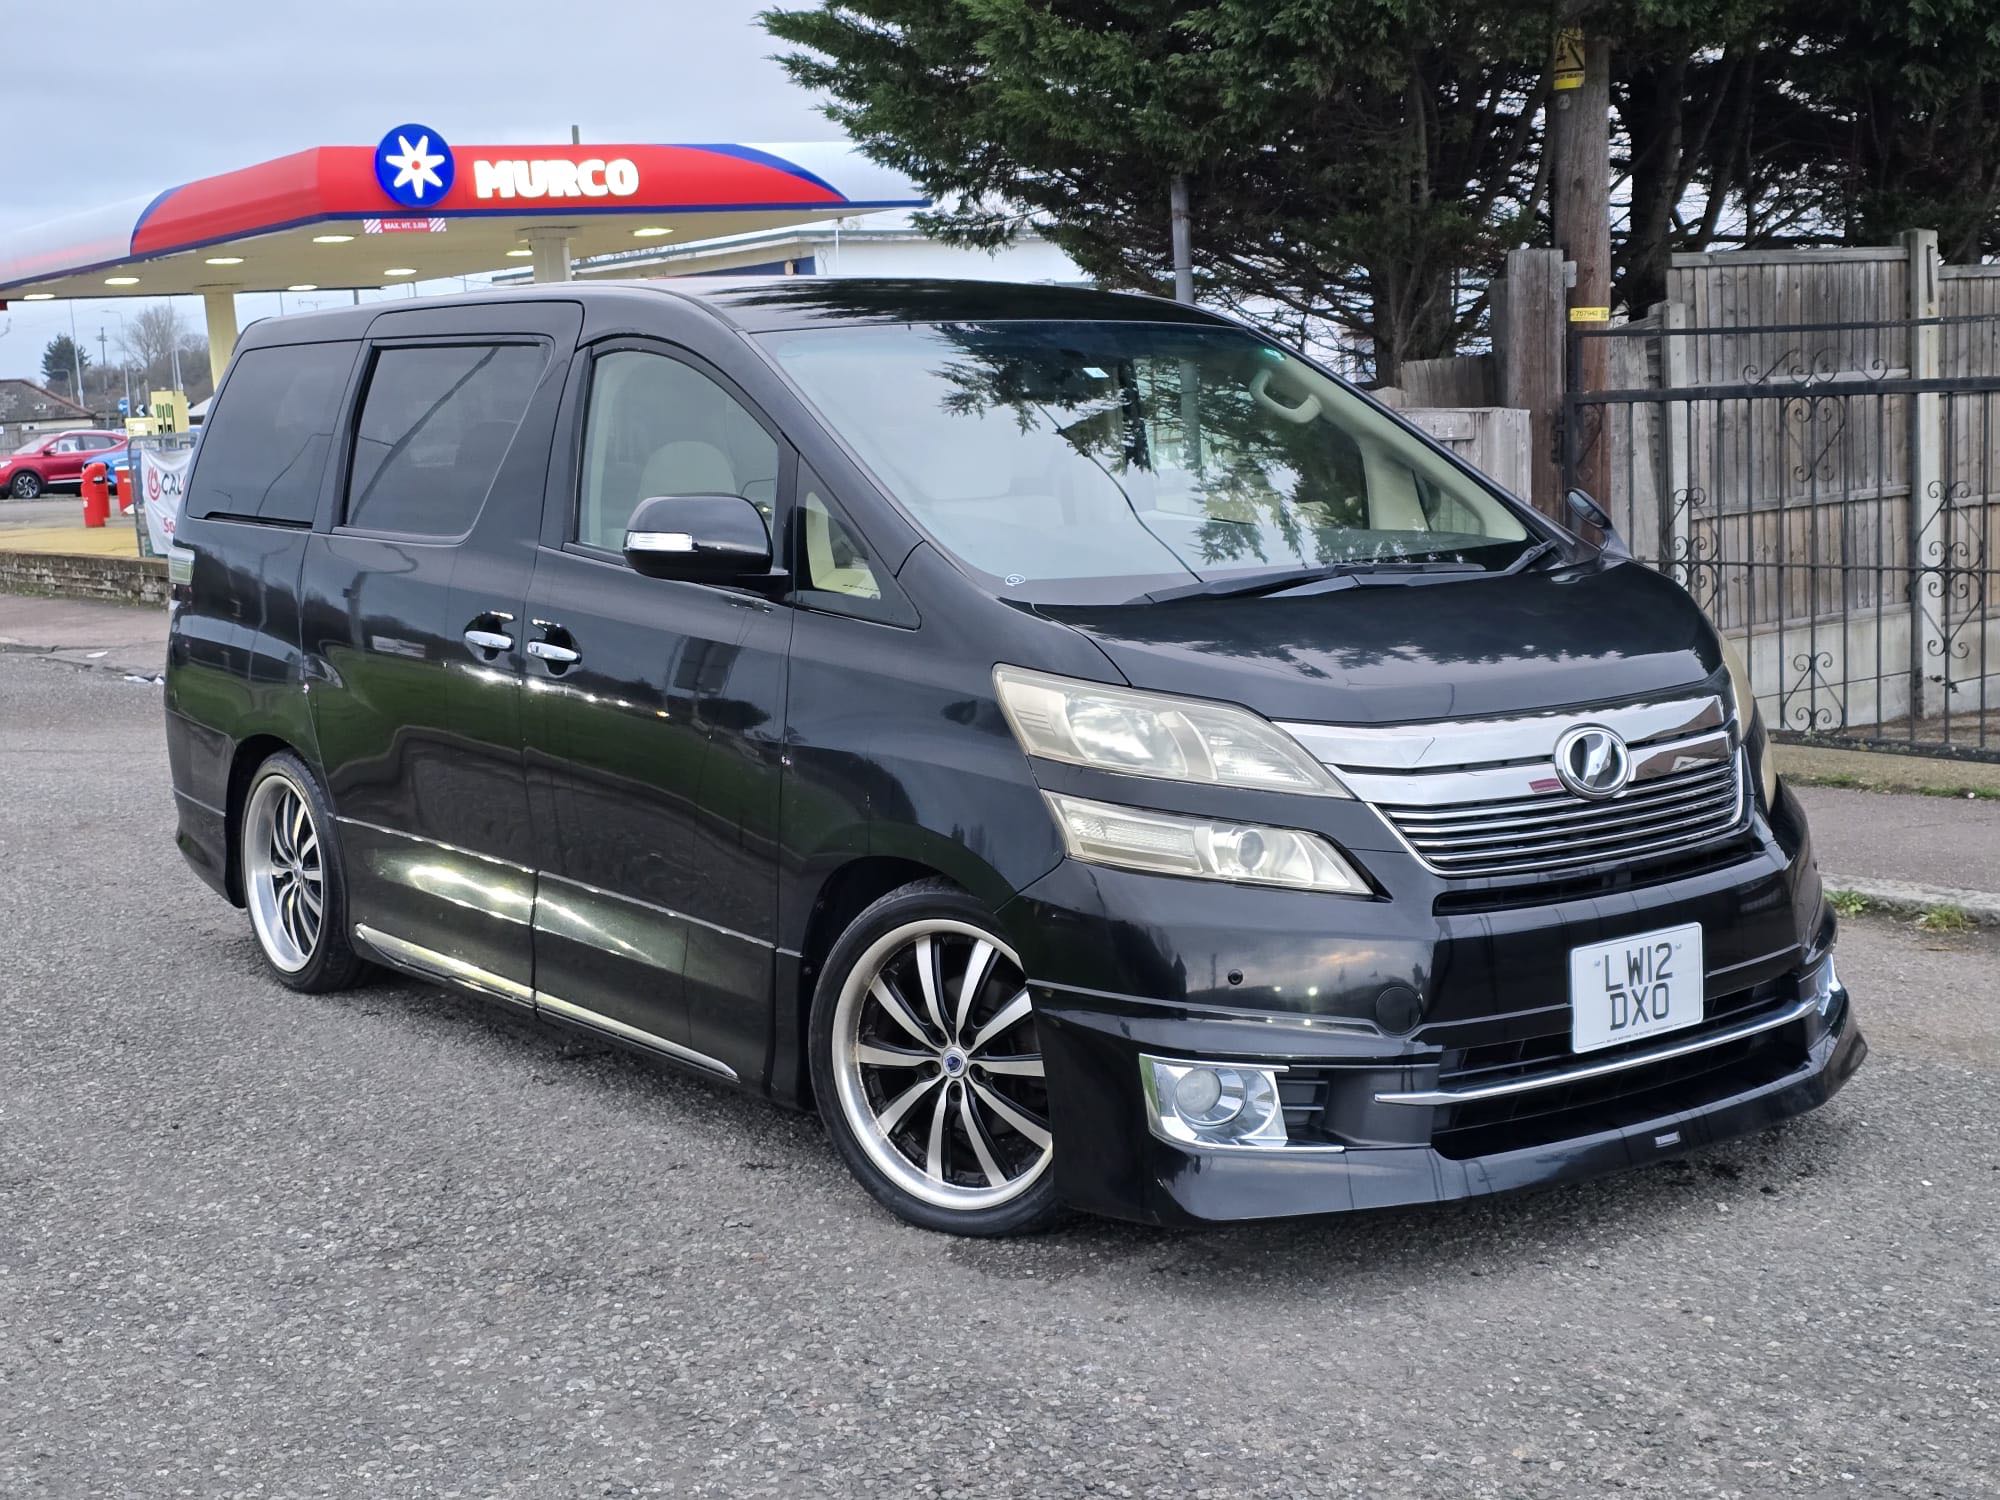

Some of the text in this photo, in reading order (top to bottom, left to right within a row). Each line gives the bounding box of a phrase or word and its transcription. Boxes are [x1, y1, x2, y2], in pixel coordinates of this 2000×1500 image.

[473, 158, 639, 199] MURCO
[161, 472, 186, 495] CAL
[1605, 942, 1673, 992] LW12
[1609, 982, 1669, 1031] DXO
